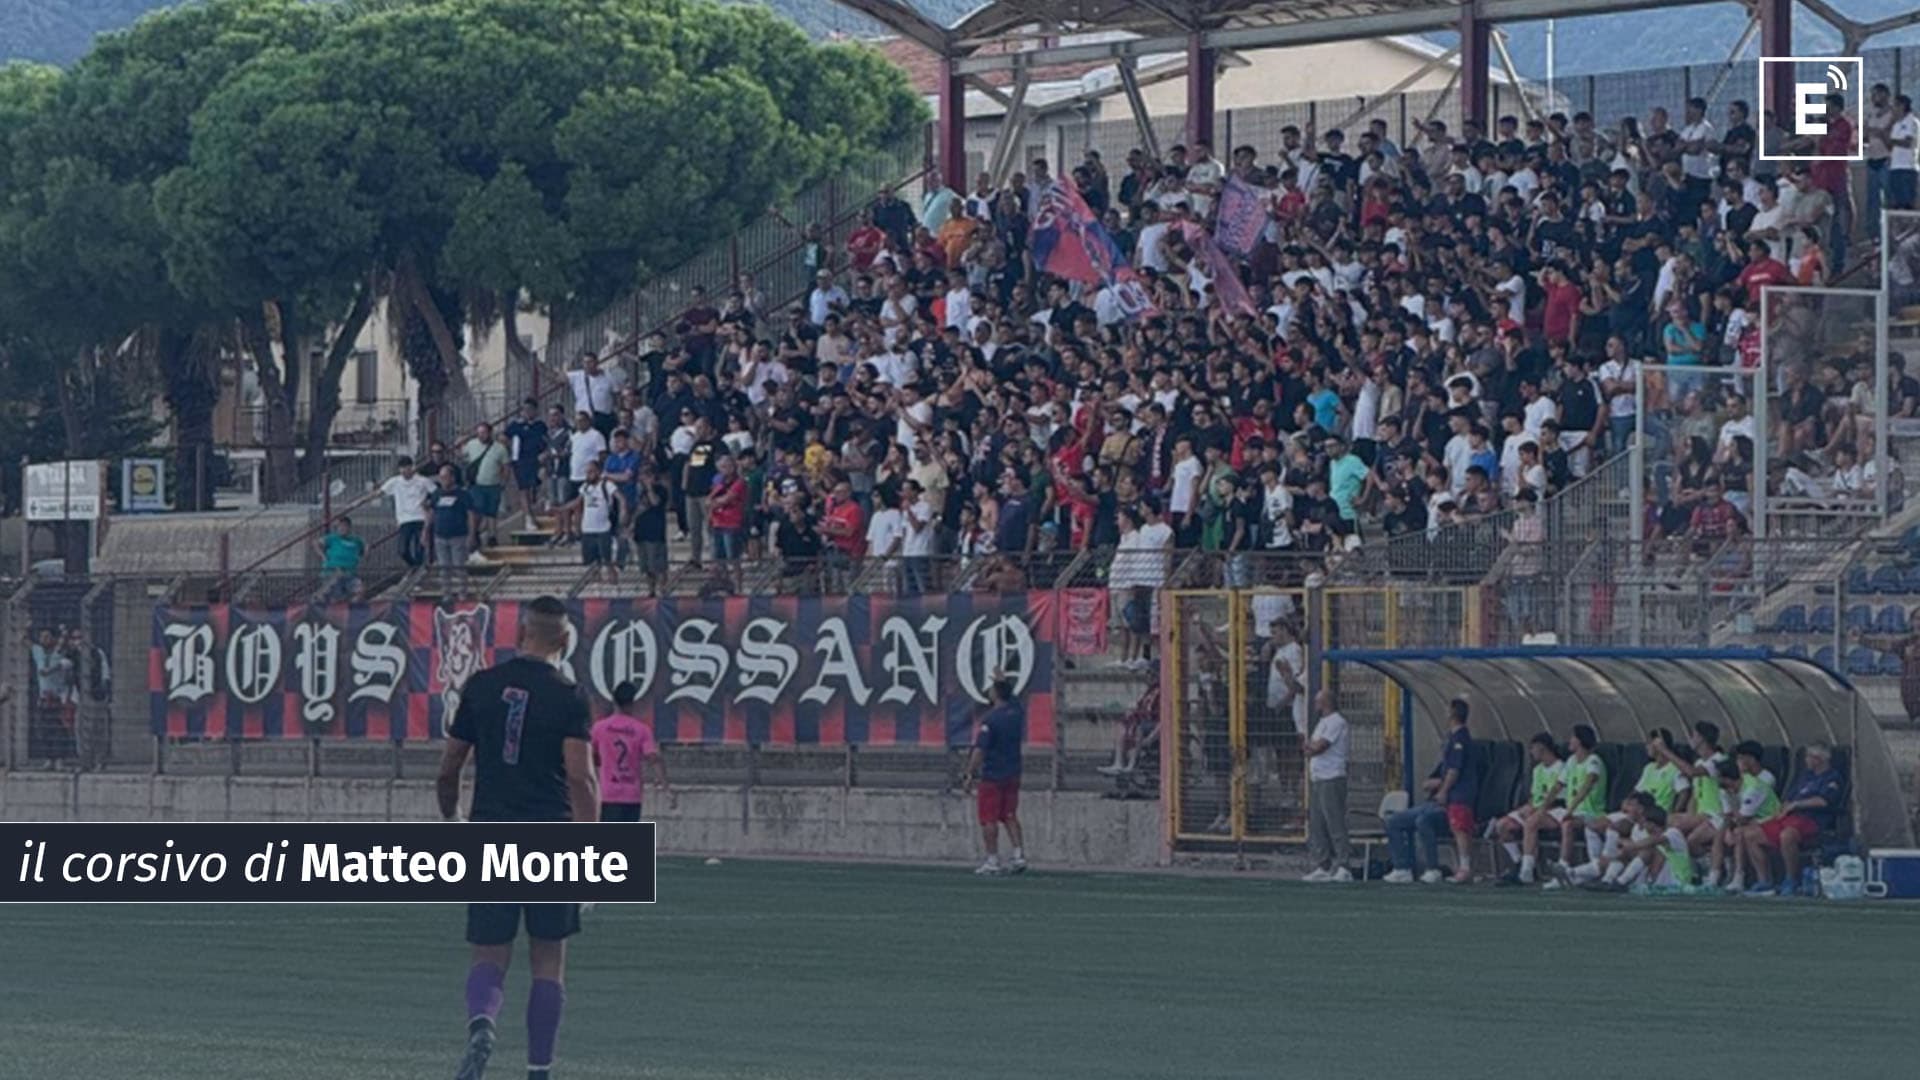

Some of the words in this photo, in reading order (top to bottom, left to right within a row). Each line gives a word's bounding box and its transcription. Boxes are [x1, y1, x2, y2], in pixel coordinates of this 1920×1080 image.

[164, 620, 407, 722] BOYS
[502, 687, 529, 765] 1
[614, 739, 629, 772] 2
